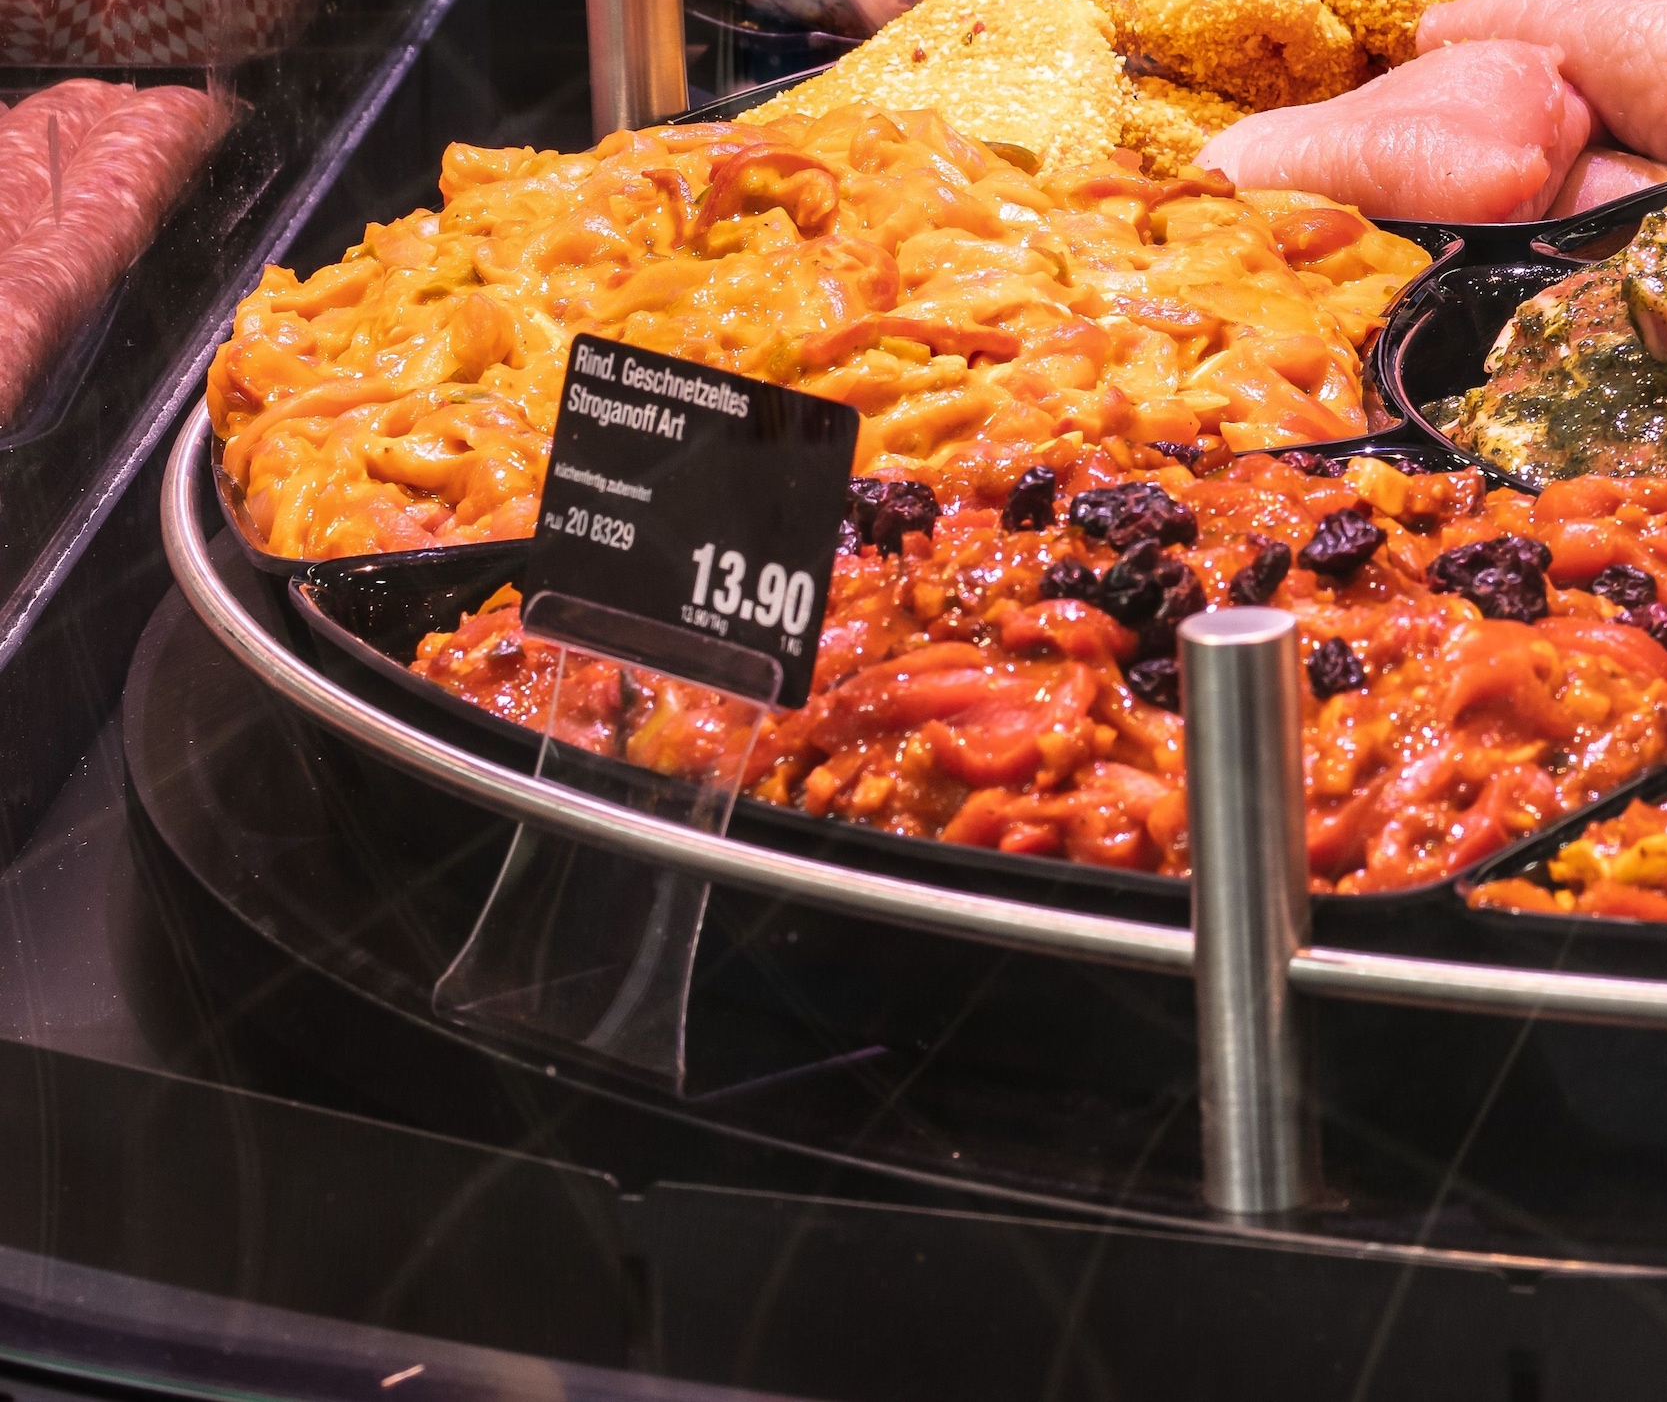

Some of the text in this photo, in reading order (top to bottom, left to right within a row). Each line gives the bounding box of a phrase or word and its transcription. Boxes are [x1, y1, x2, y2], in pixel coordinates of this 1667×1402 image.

[567, 383, 685, 440] Stroganoff Art
[574, 344, 749, 418] Rind. Geschnetzeltes
[544, 506, 635, 550] PLU 20 8329
[691, 543, 815, 635] 13.90
